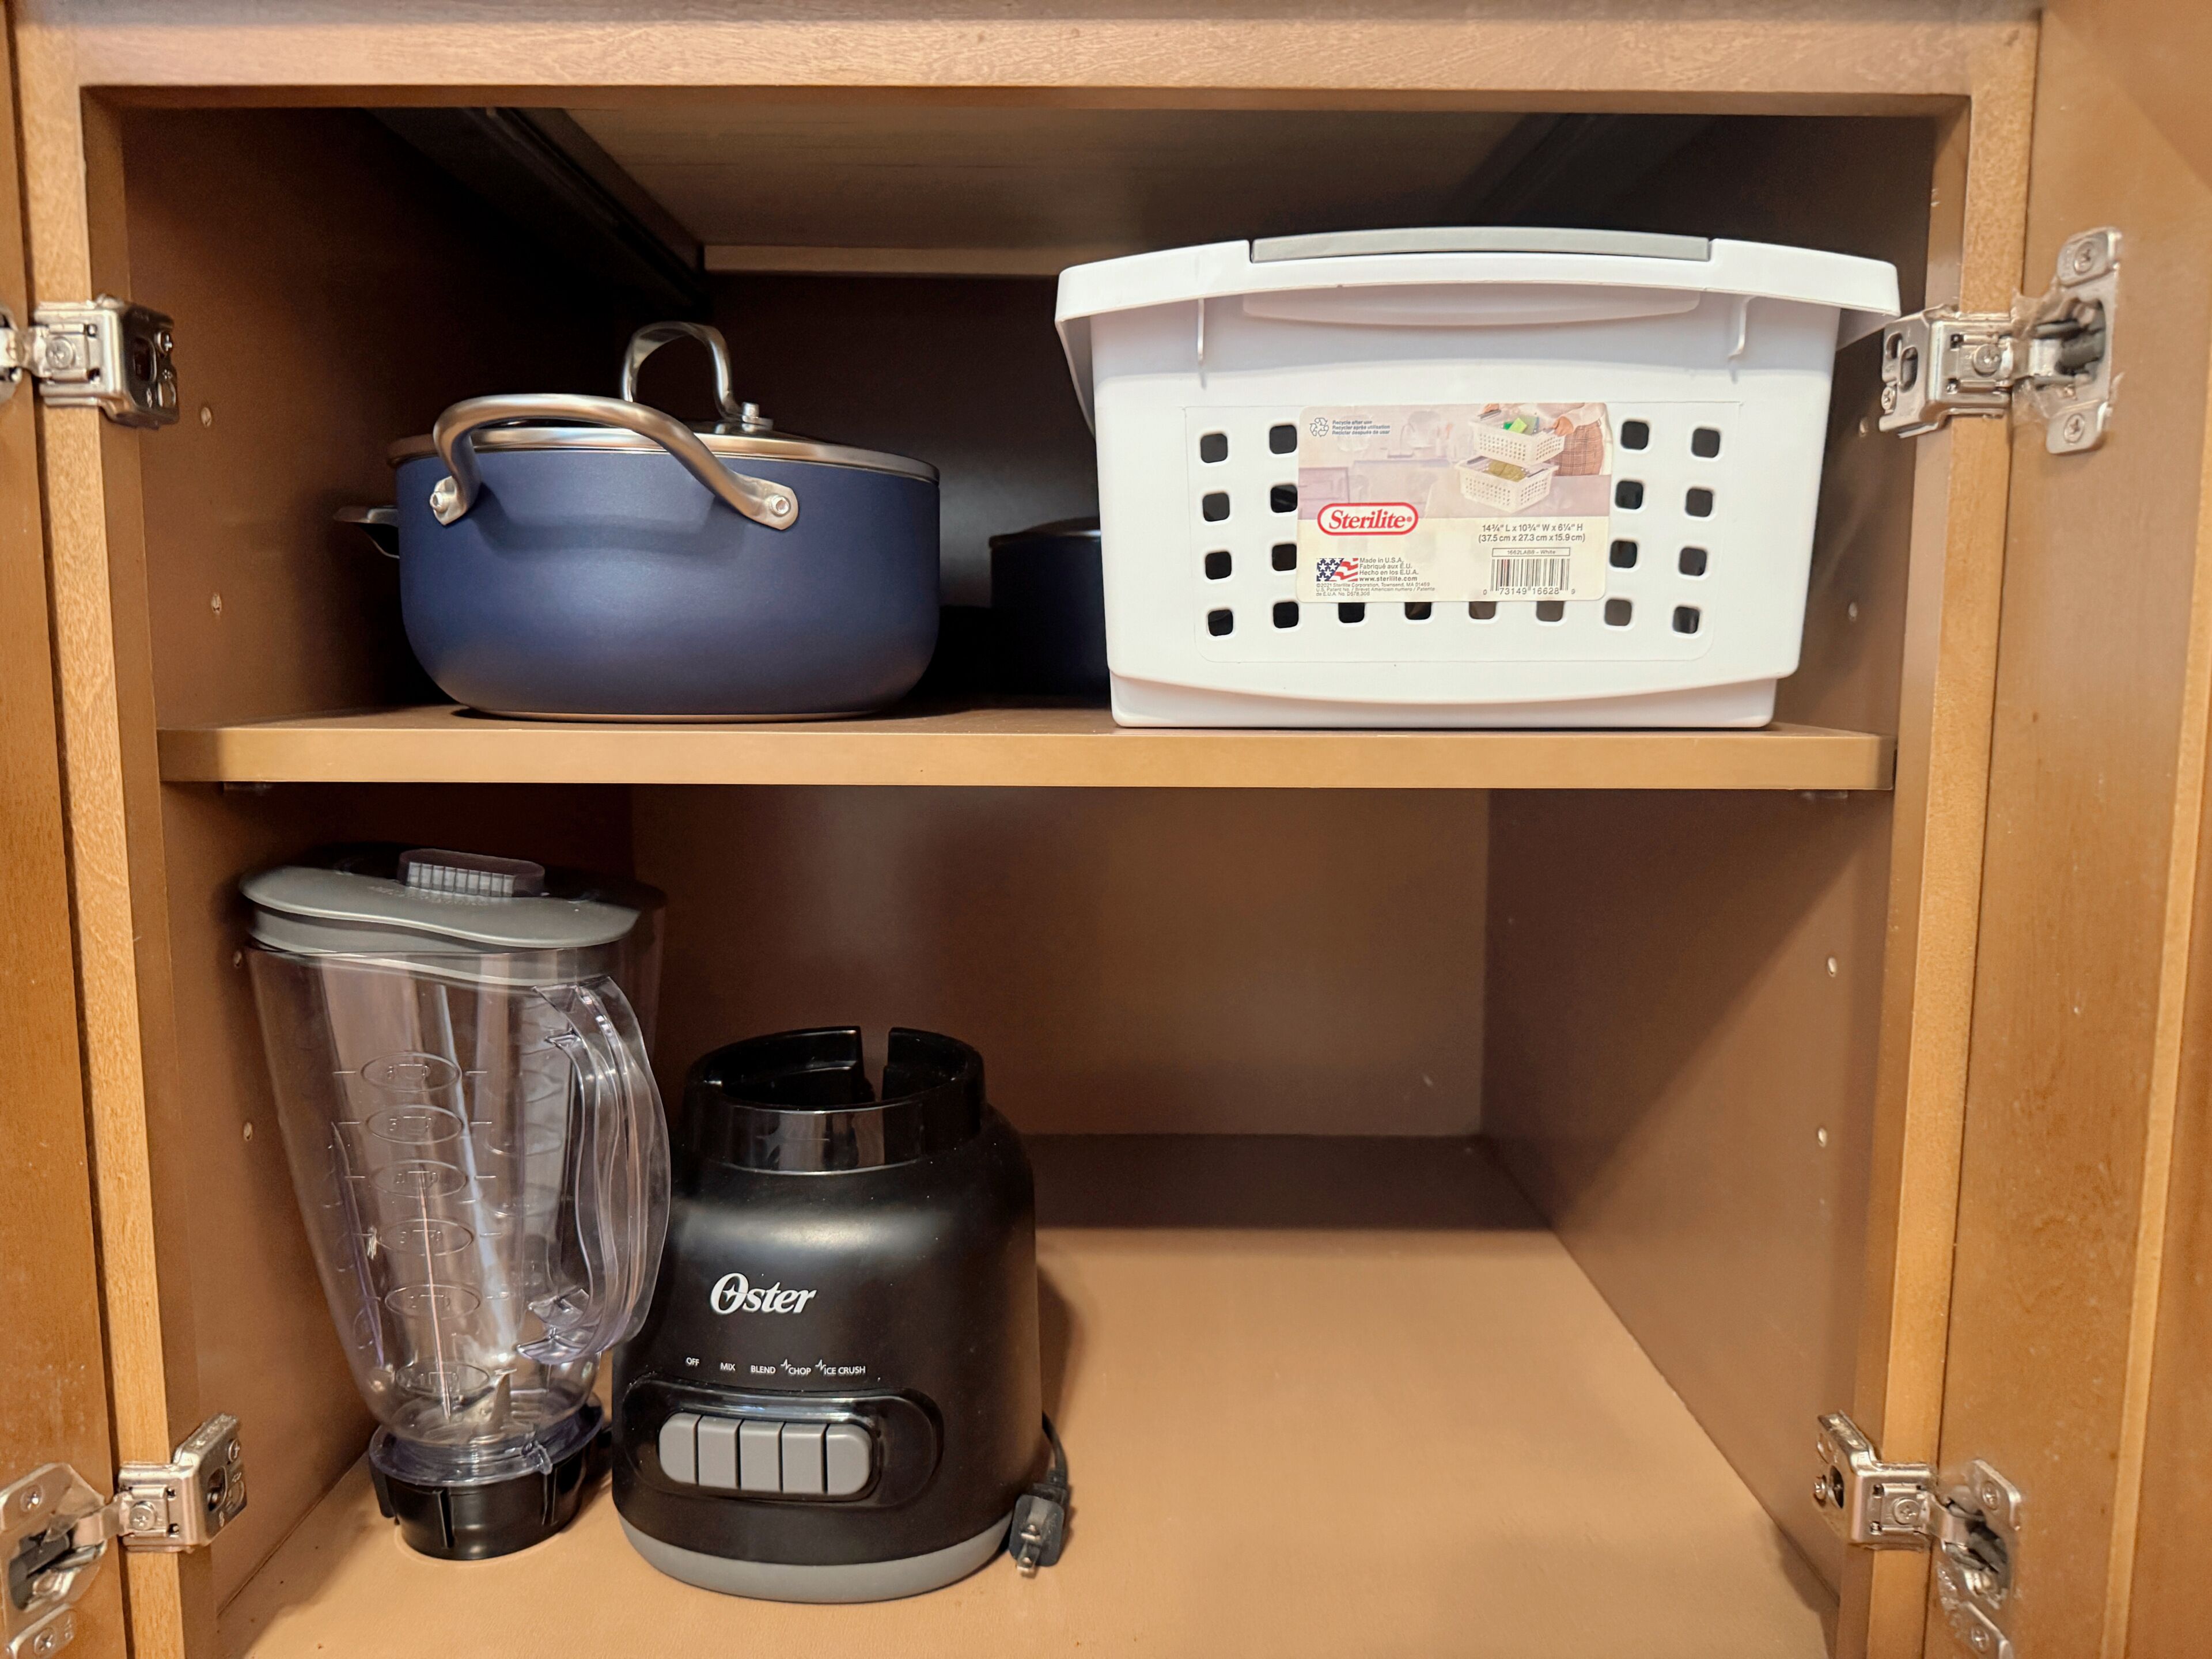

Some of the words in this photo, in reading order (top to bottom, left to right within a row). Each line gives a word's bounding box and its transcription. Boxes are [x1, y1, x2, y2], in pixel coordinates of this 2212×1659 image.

[1577, 523, 1583, 531] H
[1478, 534, 1498, 543] (37.5
[1571, 533, 1585, 543] cm)
[710, 1272, 817, 1315] Oster
[686, 1357, 700, 1366] OFF
[721, 1362, 736, 1372] MIX
[751, 1365, 777, 1374] BLEND
[788, 1367, 812, 1375] CHOP
[824, 1366, 837, 1375] ICE
[838, 1366, 866, 1374] CRUSH
